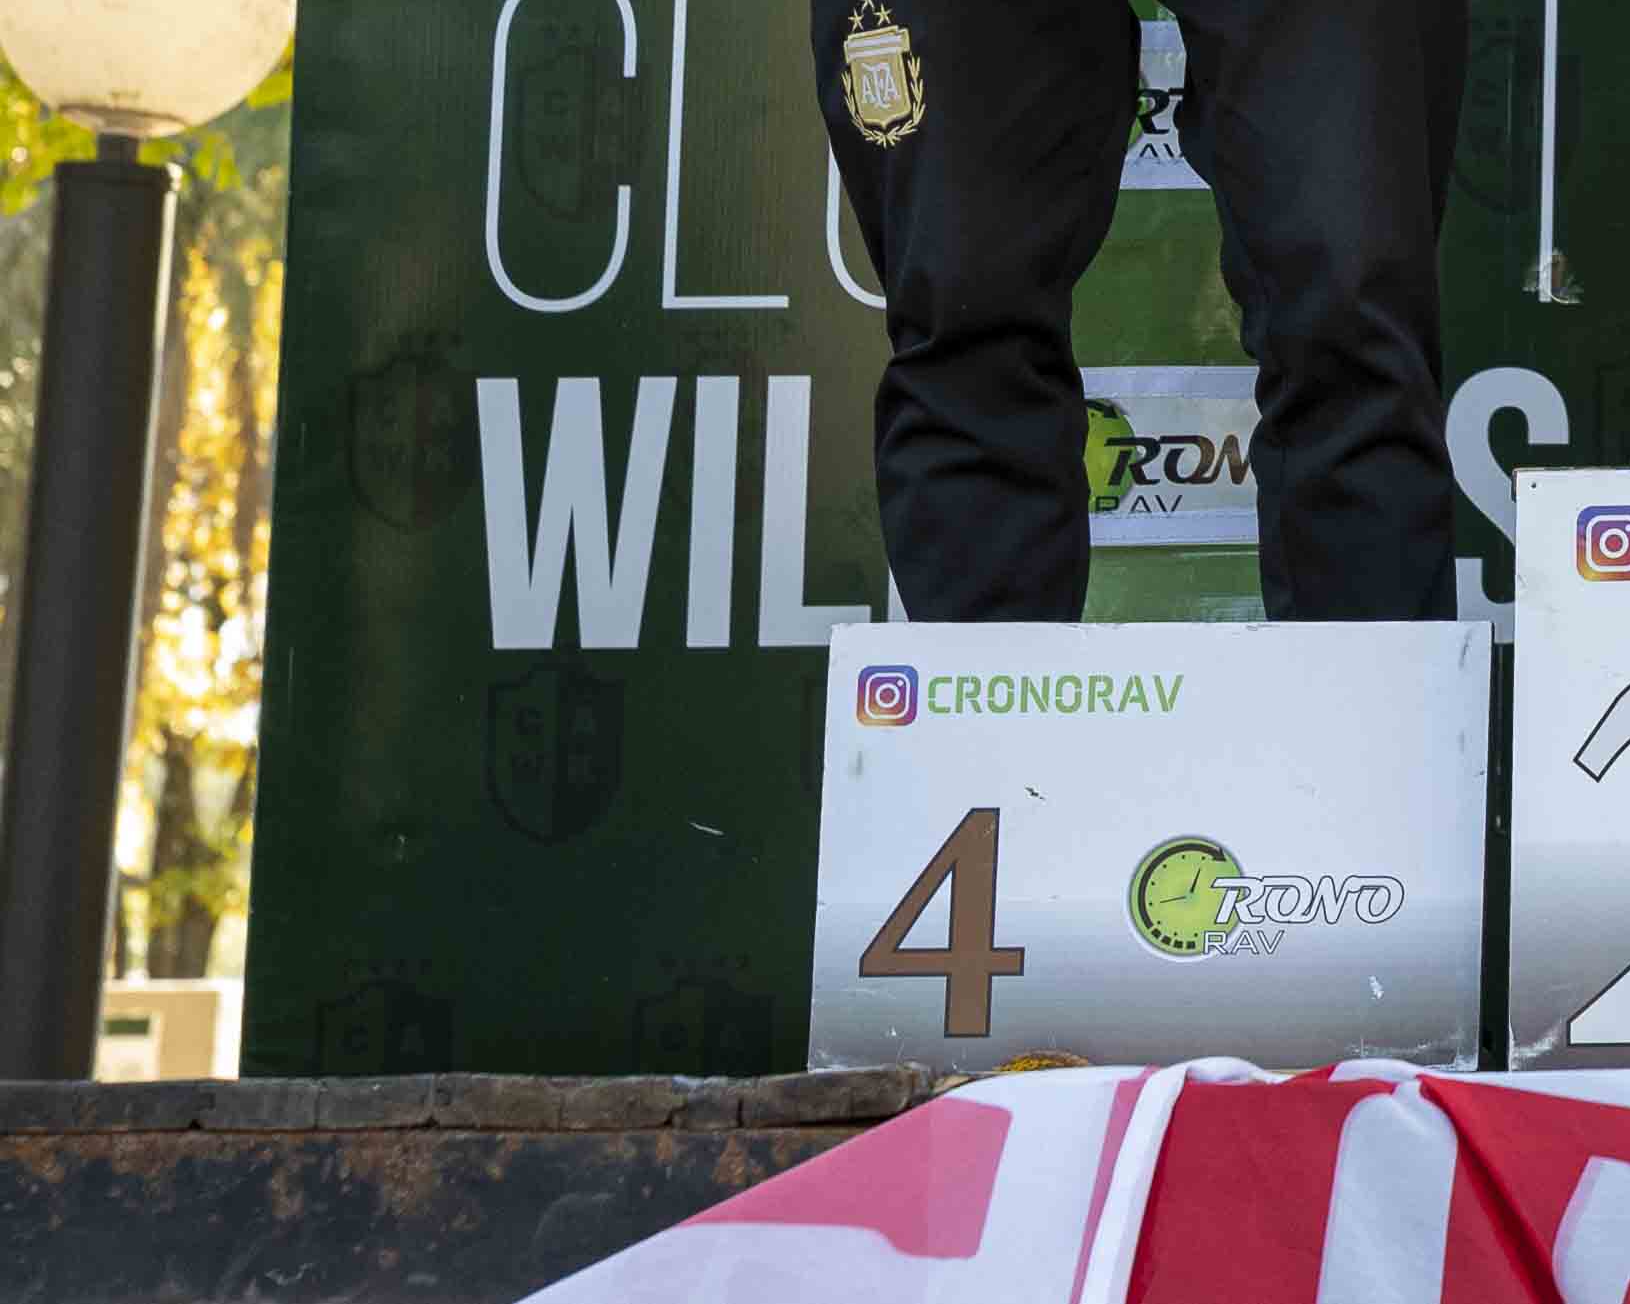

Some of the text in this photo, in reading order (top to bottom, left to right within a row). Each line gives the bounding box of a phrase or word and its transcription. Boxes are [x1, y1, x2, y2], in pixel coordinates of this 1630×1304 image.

[926, 673, 1185, 715] CRONORAV
[858, 806, 1025, 1038] 4
[1202, 929, 1286, 956] RAV
